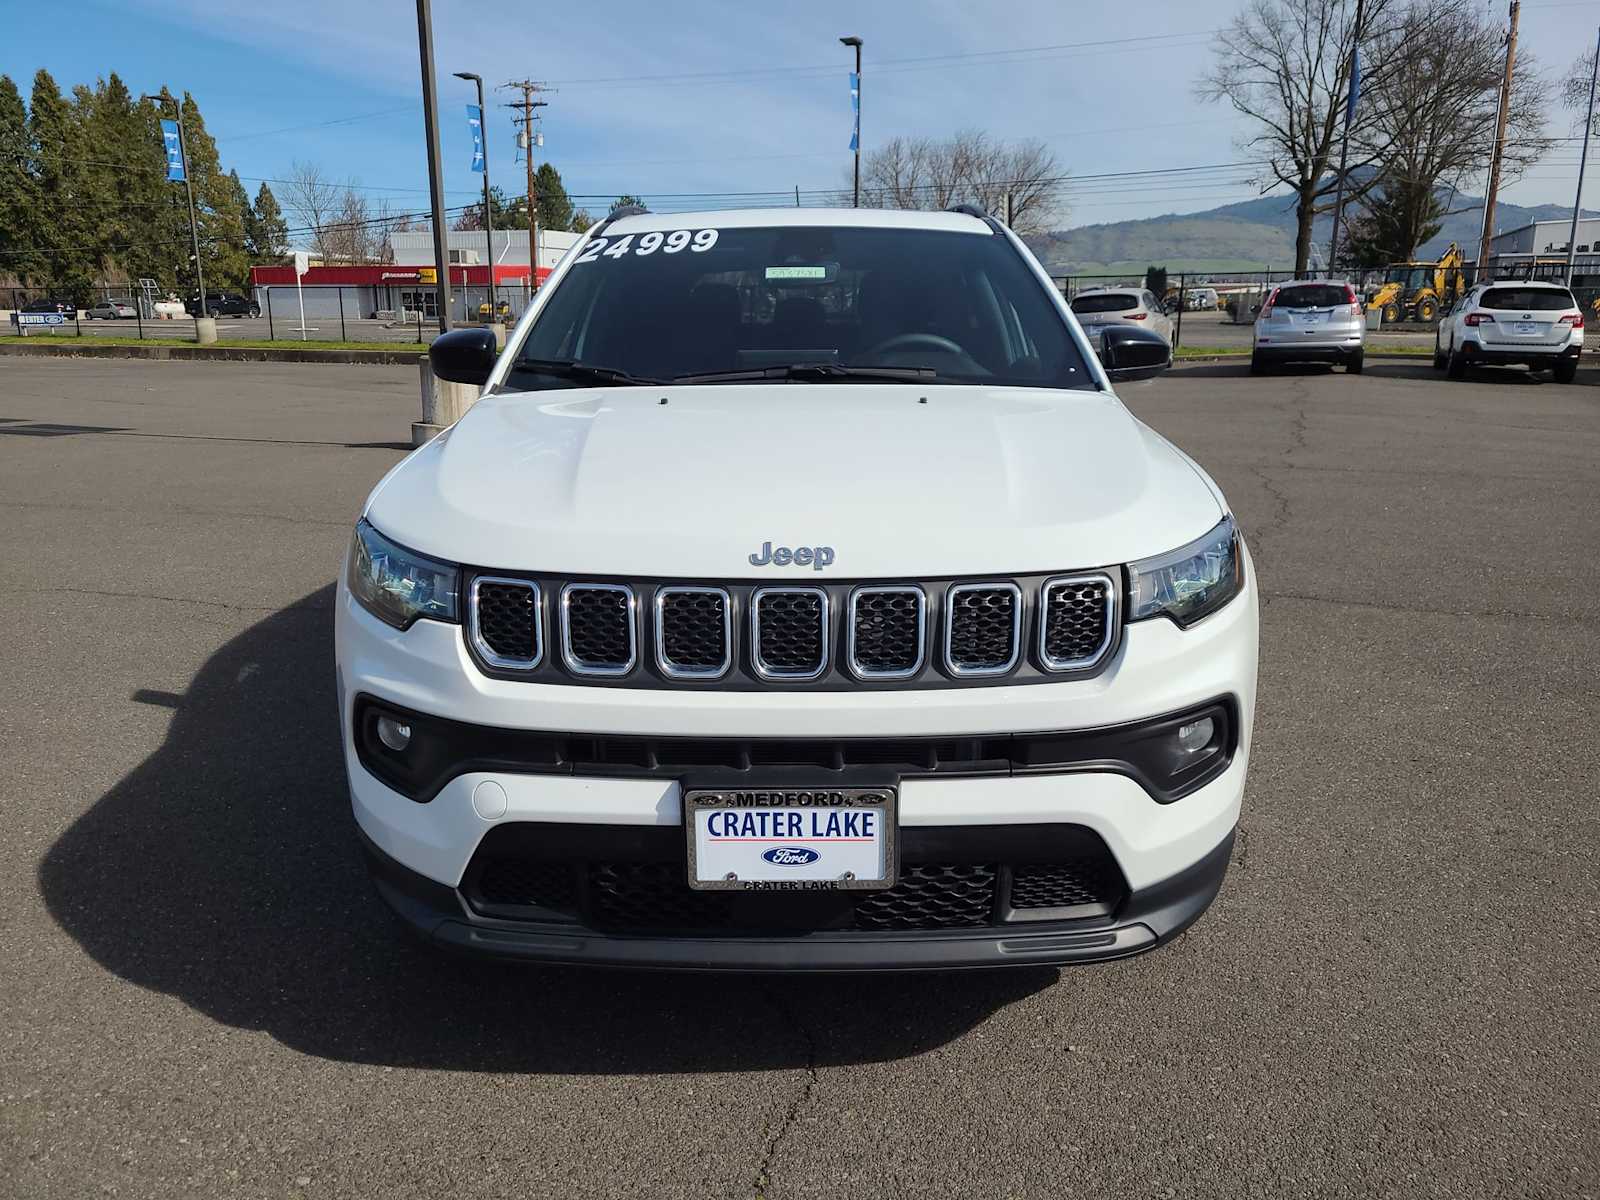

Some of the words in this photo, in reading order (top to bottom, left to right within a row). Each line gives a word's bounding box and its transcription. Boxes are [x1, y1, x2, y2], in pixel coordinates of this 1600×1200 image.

[574, 228, 719, 264] 24999
[748, 541, 835, 571] Jeep
[736, 792, 844, 807] MEDFORD
[707, 812, 803, 837] CRATER
[811, 812, 874, 837] LAKE
[772, 847, 809, 865] Ford
[743, 881, 798, 890] CRATER
[802, 881, 838, 890] LAKE
